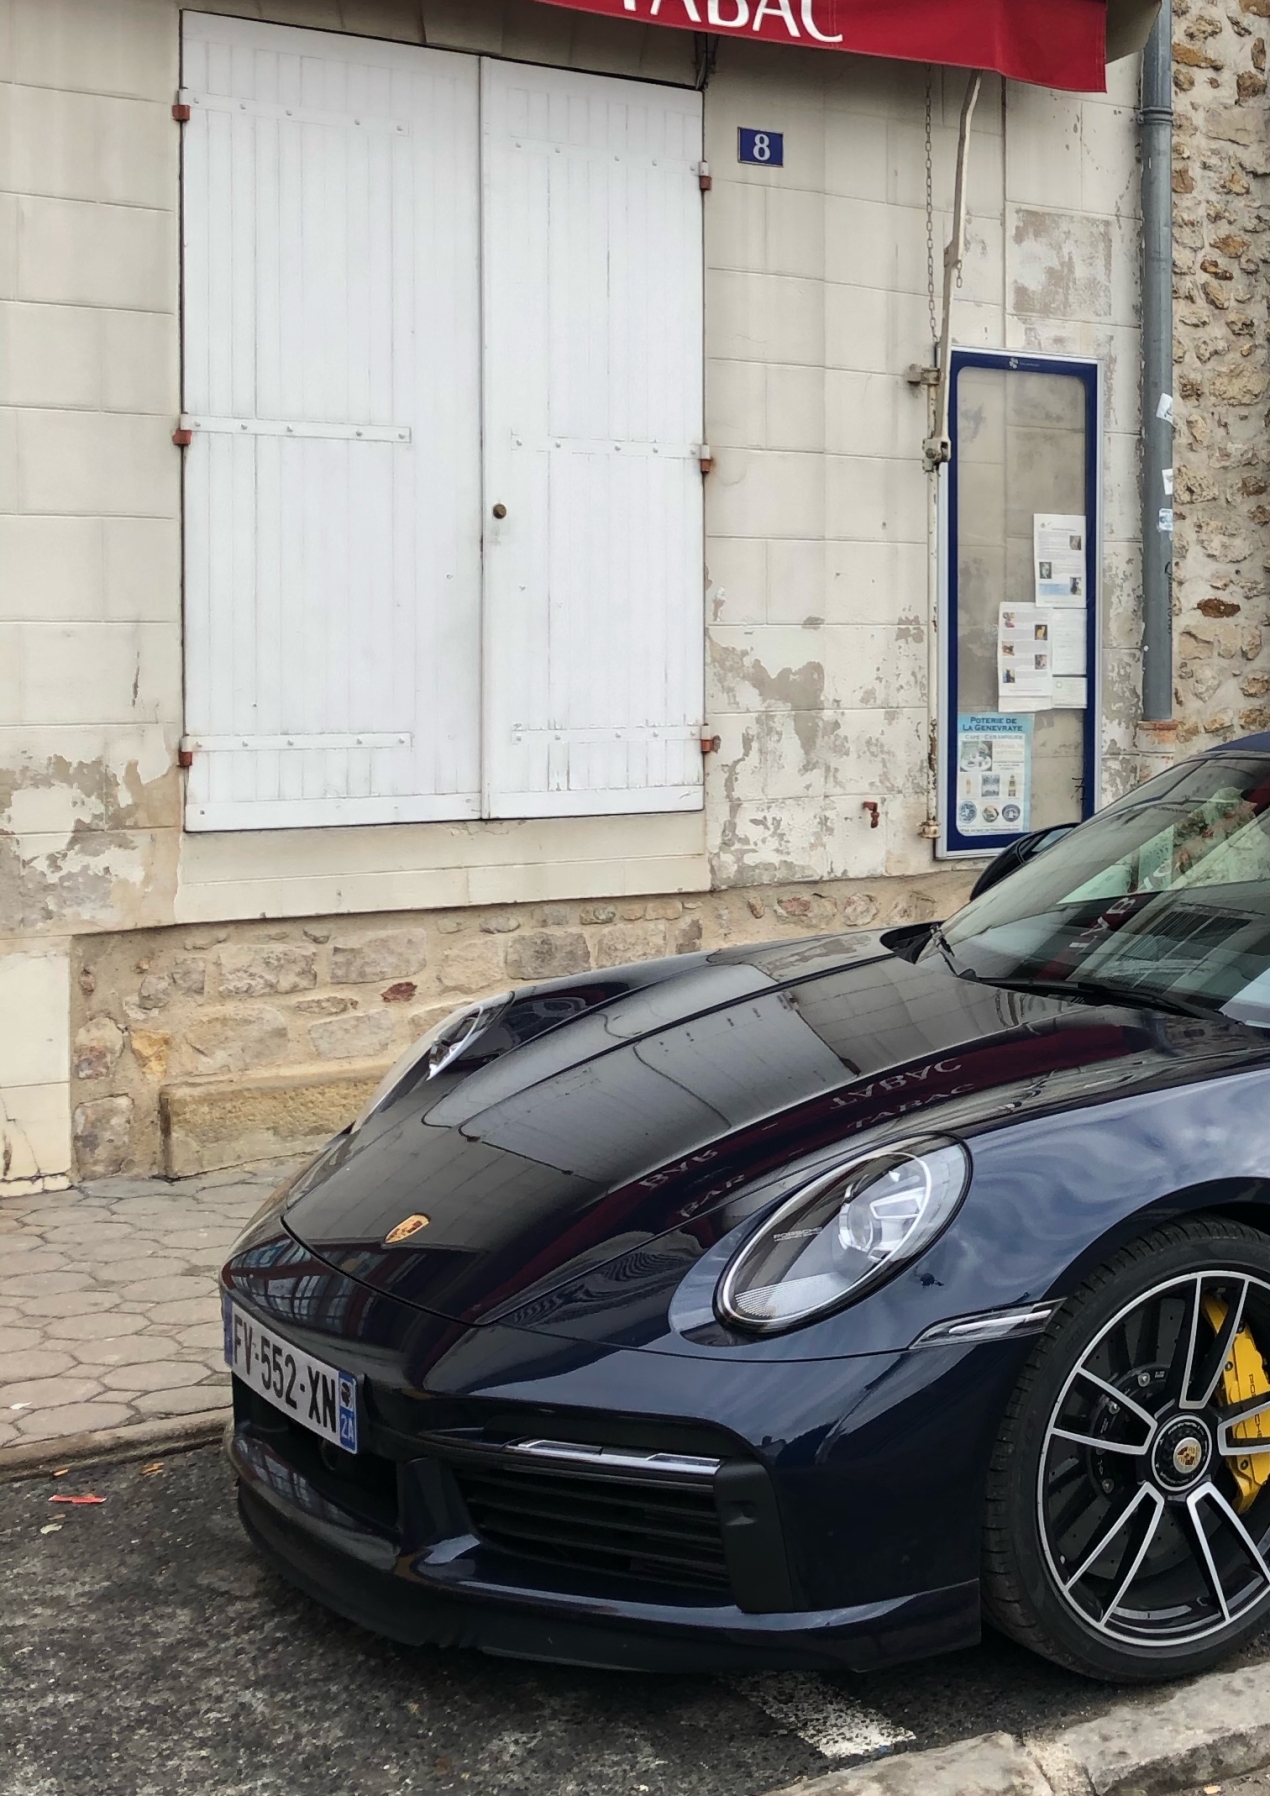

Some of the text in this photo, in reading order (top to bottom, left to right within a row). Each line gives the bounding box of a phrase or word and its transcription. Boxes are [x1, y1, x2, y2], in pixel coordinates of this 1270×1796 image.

[753, 133, 770, 161] 8
[970, 716, 1004, 724] POTERIE
[234, 1314, 337, 1433] FV-552-XN
[340, 1414, 354, 1443] 2A
